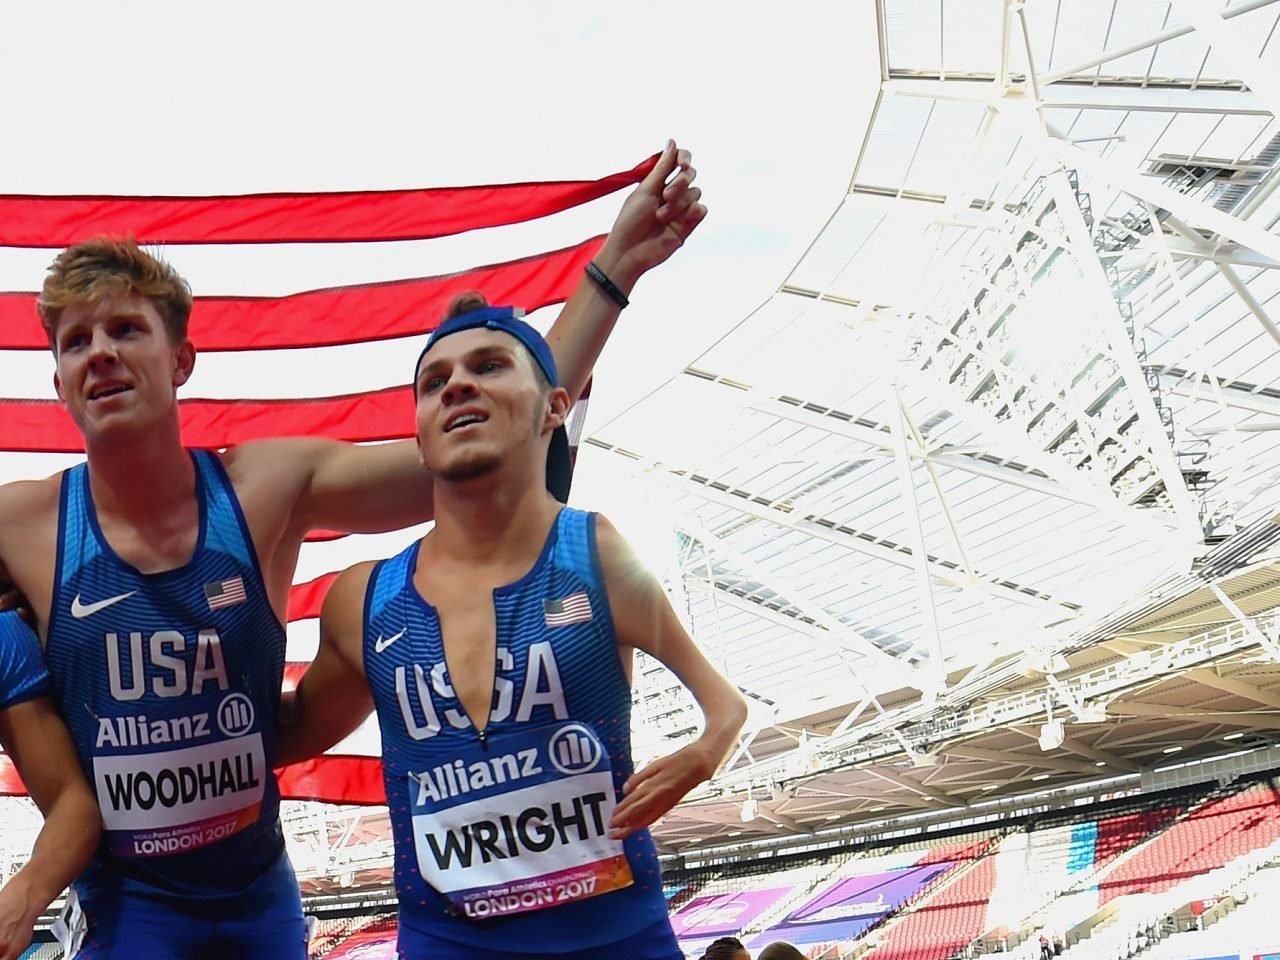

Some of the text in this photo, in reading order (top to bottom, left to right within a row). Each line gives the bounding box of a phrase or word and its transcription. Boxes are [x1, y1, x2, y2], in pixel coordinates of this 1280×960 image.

[105, 628, 230, 701] USA
[395, 640, 569, 741] USA
[95, 713, 211, 748] Allianz
[104, 752, 259, 811] WOODHALL
[415, 748, 542, 807] Allianz
[134, 832, 203, 854] LONDON
[206, 820, 237, 841] 2017
[425, 792, 608, 870] WRIGHT
[464, 876, 597, 917] LONDON 2017
